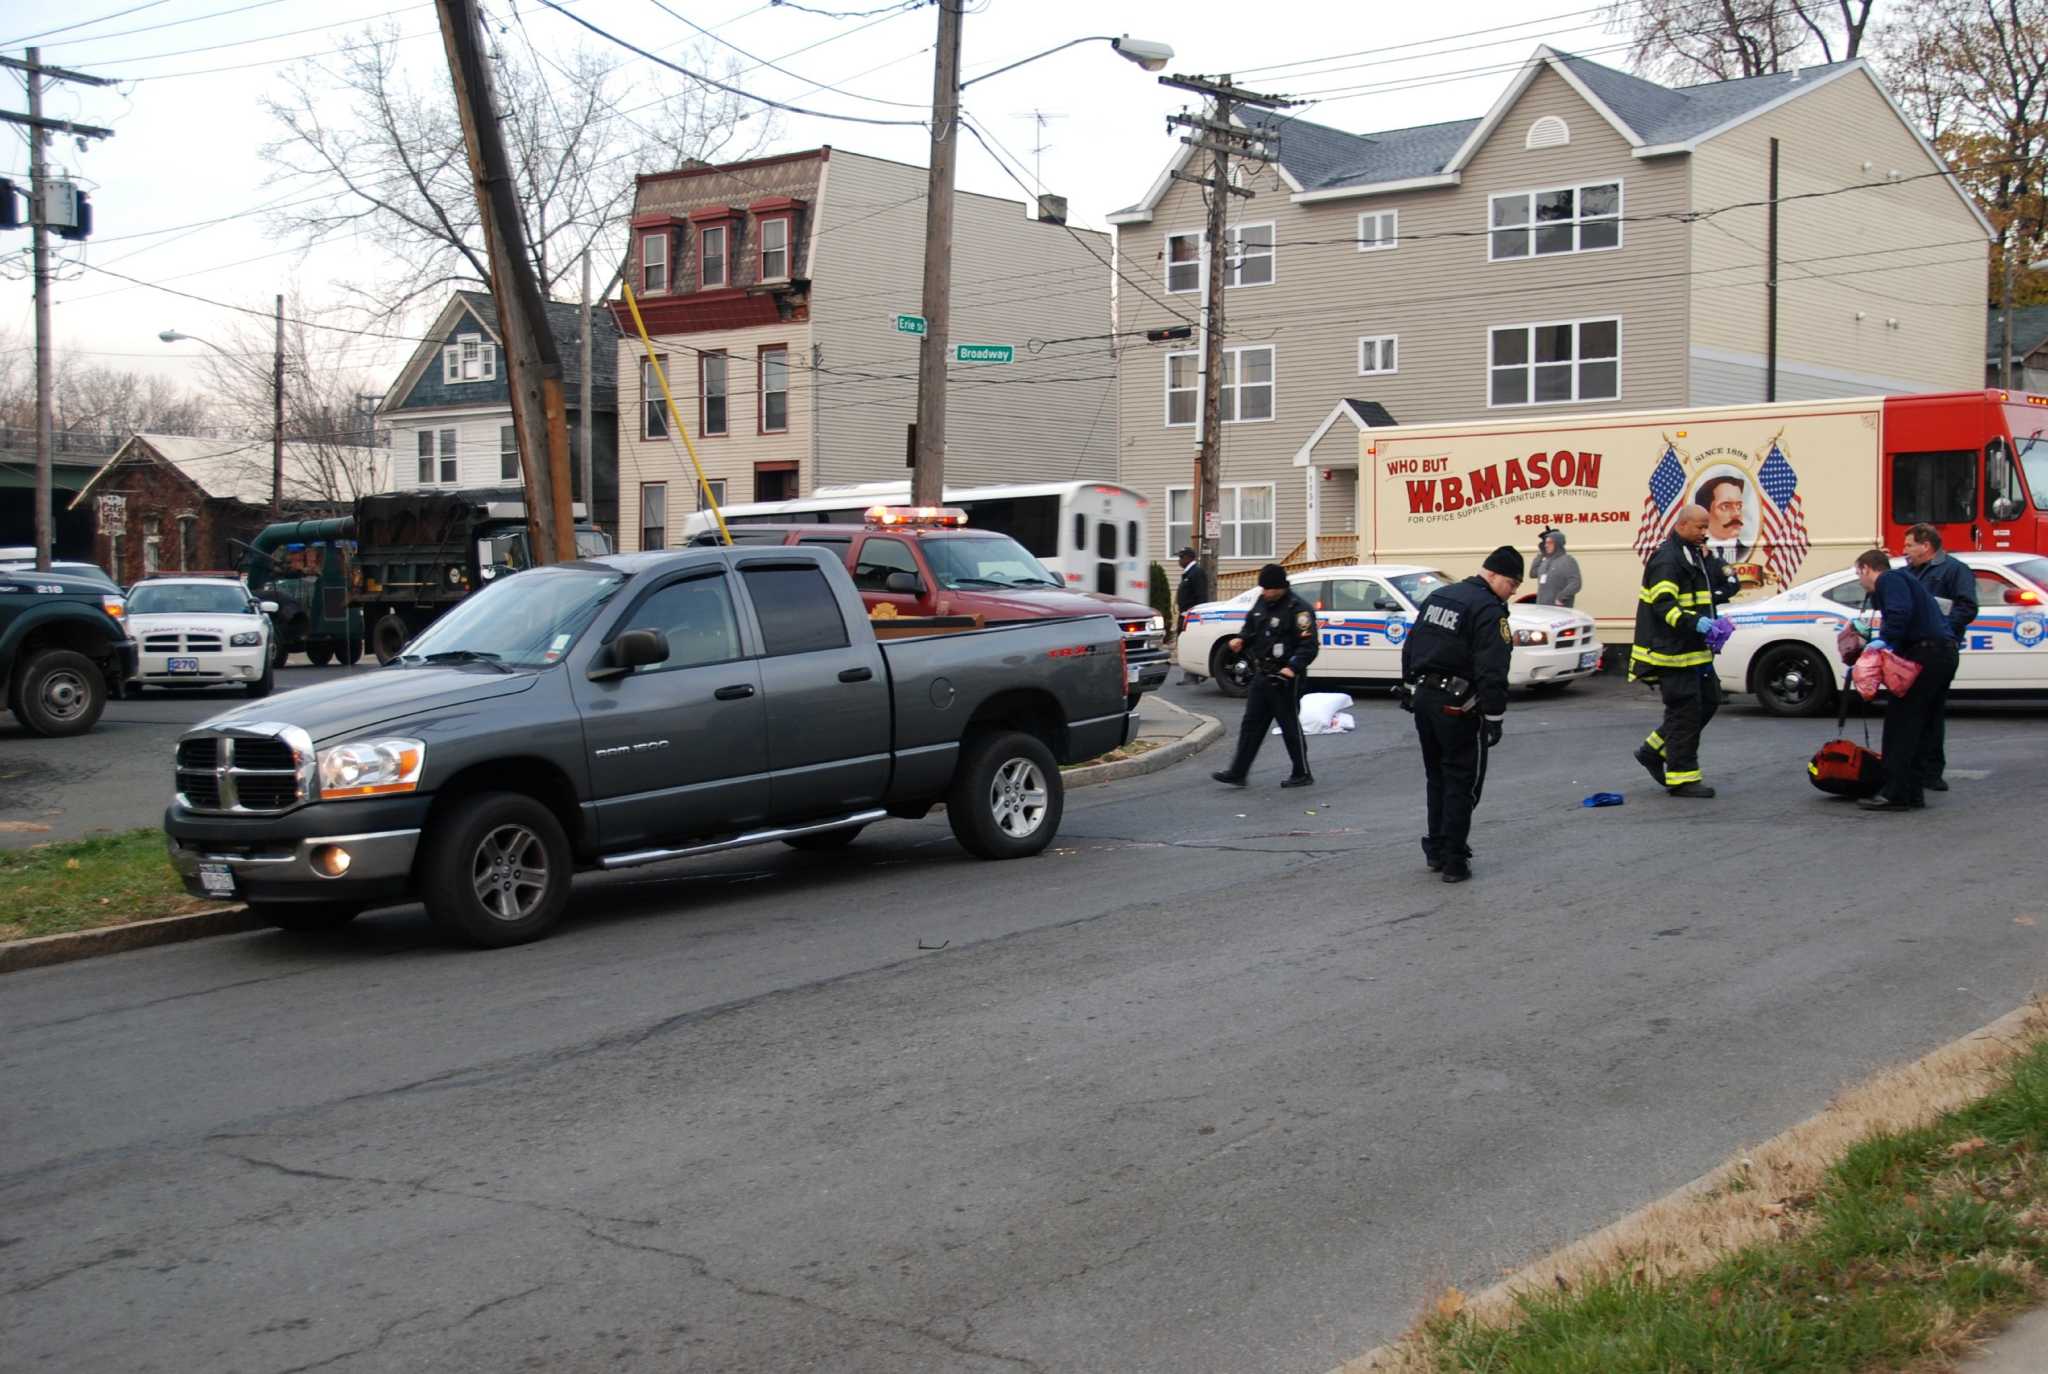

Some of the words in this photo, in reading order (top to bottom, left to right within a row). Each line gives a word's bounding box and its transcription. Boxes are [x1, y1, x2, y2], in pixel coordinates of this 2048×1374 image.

[899, 318, 915, 330] Erie
[960, 348, 1009, 361] Broadway
[1695, 447, 1724, 463] SINCE
[1387, 459, 1417, 475] WHO
[1422, 457, 1449, 473] BUT
[1408, 515, 1425, 524] FOR
[1427, 512, 1455, 524] OFFICE
[1499, 490, 1546, 506] FURNITURE
[1549, 489, 1555, 498] &
[1557, 488, 1598, 499] PRINTING
[1514, 511, 1630, 525] 1-888-WB-MASON
[1424, 604, 1459, 631] POLICE
[1318, 633, 1371, 646] ICE
[175, 660, 197, 670] 270
[633, 740, 669, 751] 1500
